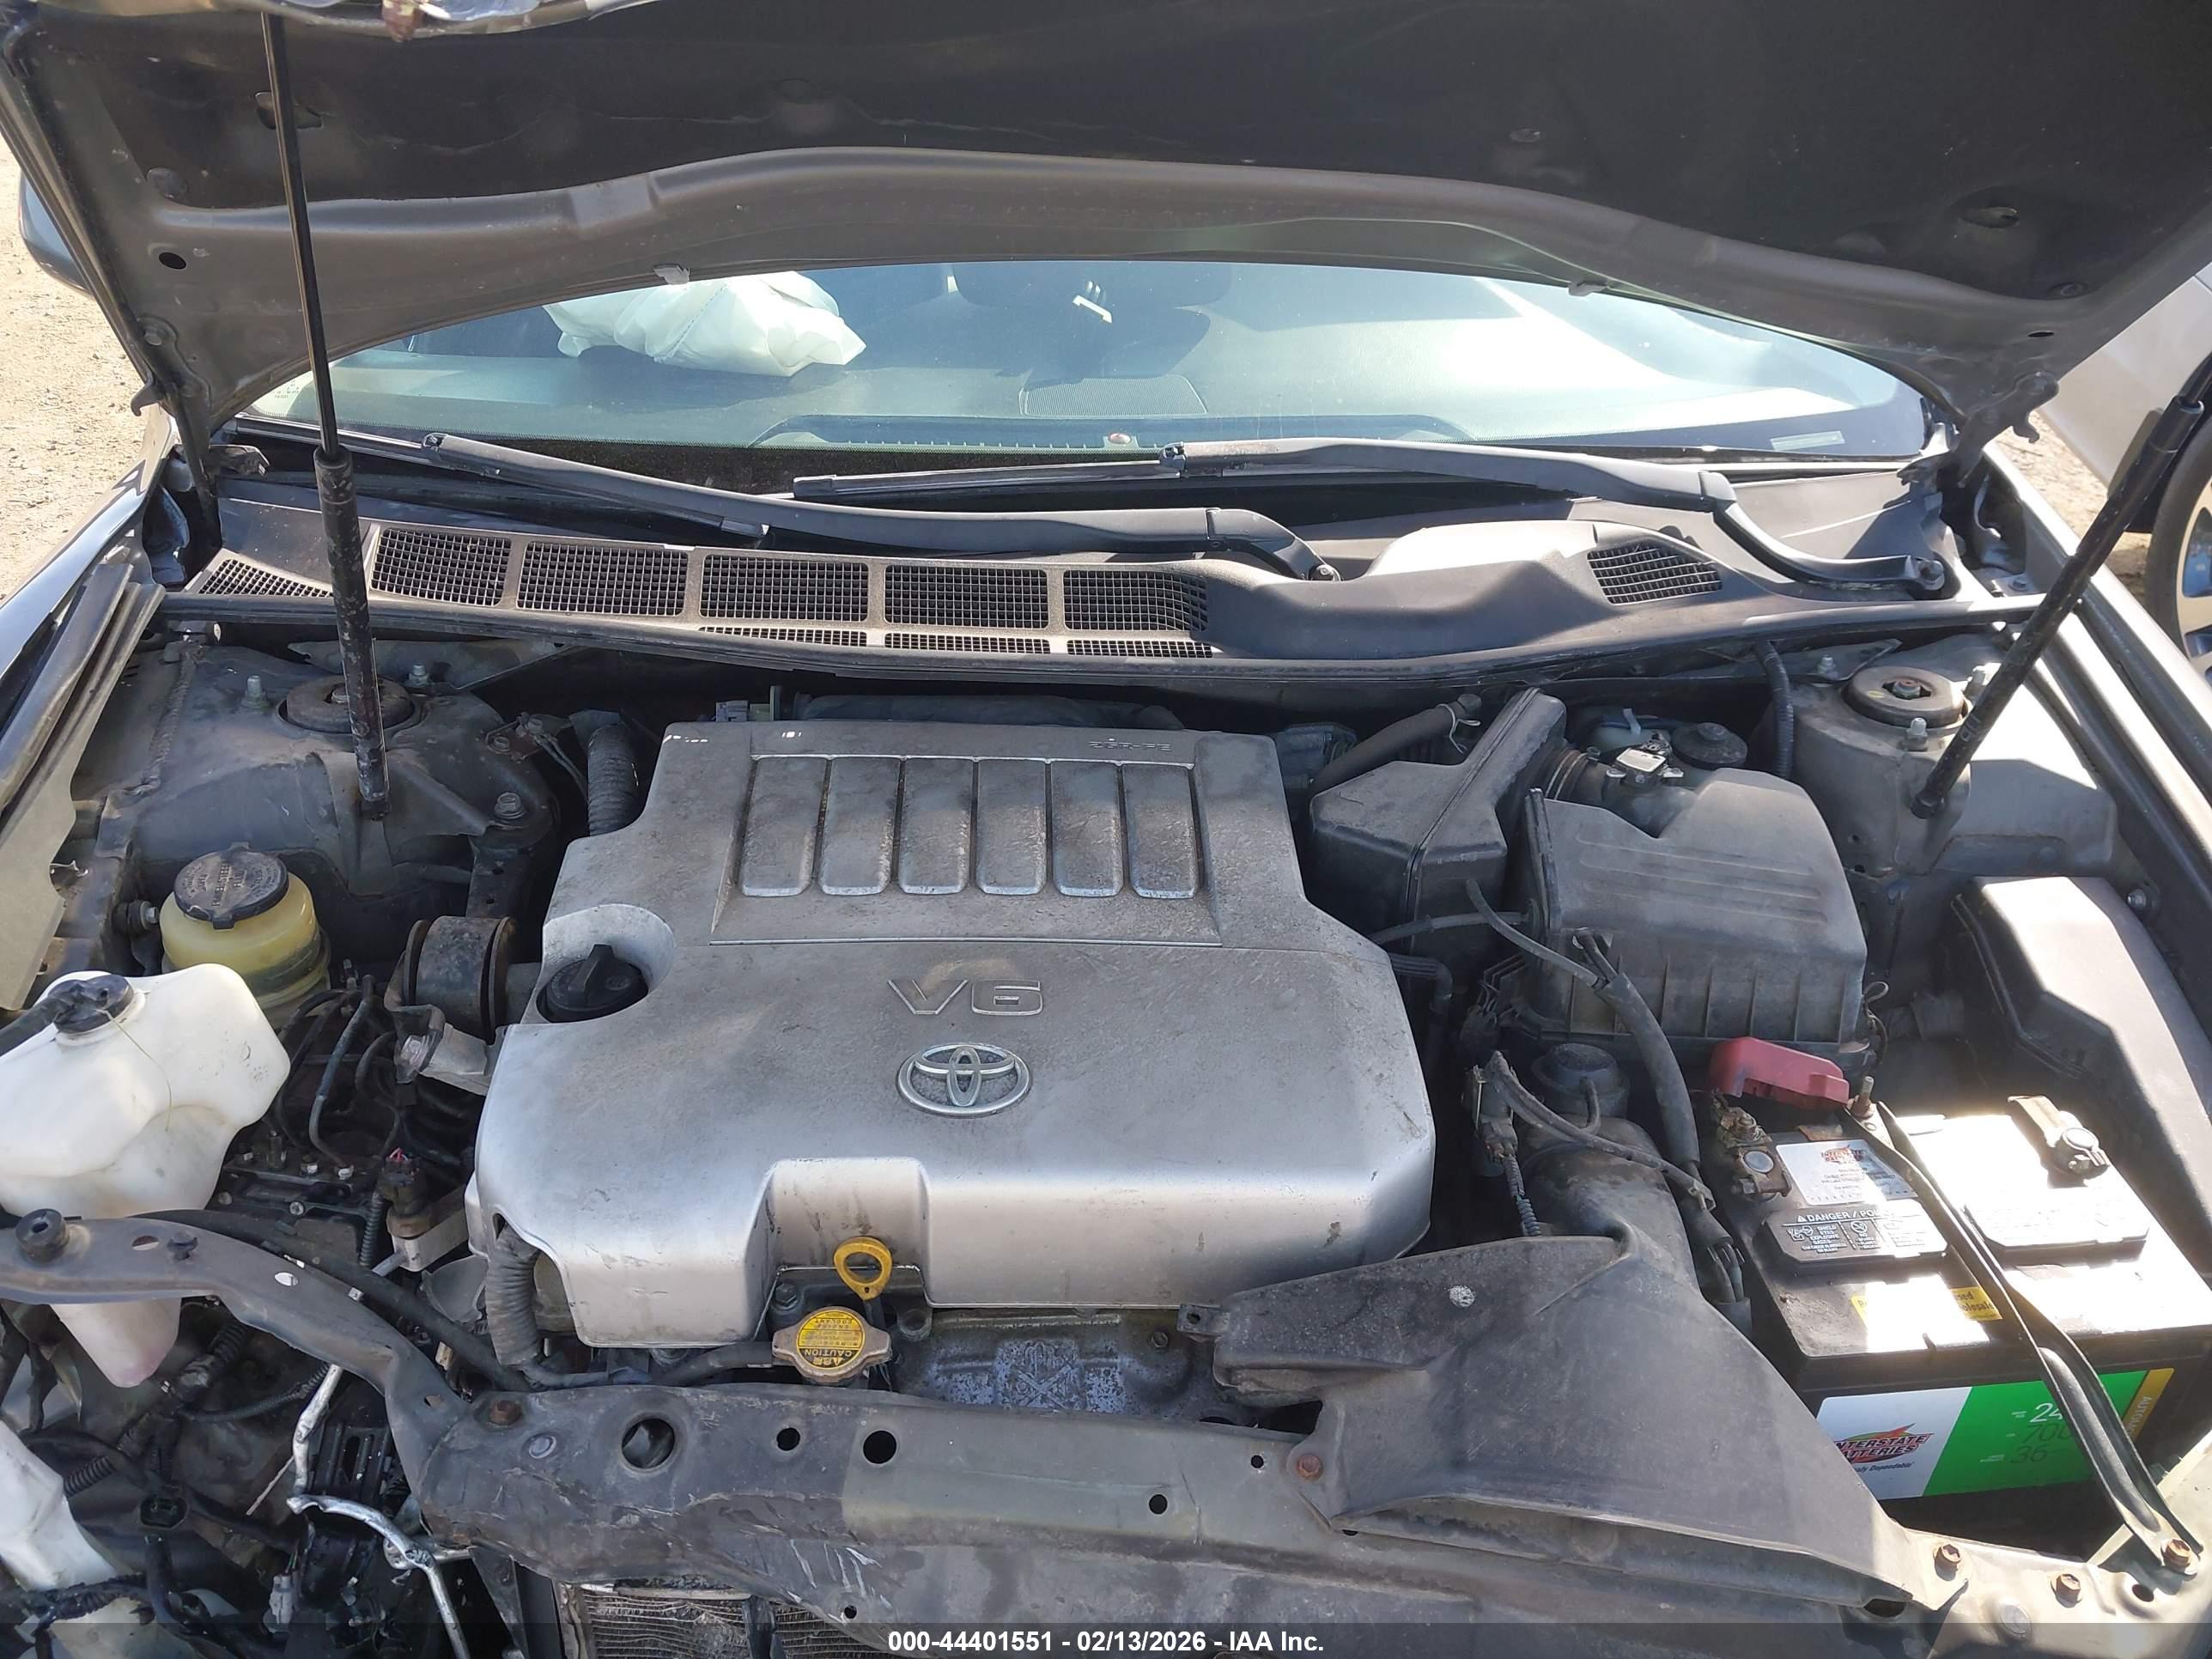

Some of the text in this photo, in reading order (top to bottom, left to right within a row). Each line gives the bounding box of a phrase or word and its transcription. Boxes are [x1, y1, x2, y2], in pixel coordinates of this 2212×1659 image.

[888, 979, 1043, 1016] V6
[1808, 1211, 1850, 1222] DANGER
[804, 1348, 853, 1358] CAUTION
[1836, 1435, 1928, 1449] NTERSTATE
[1843, 1444, 1917, 1458] ATTERIES
